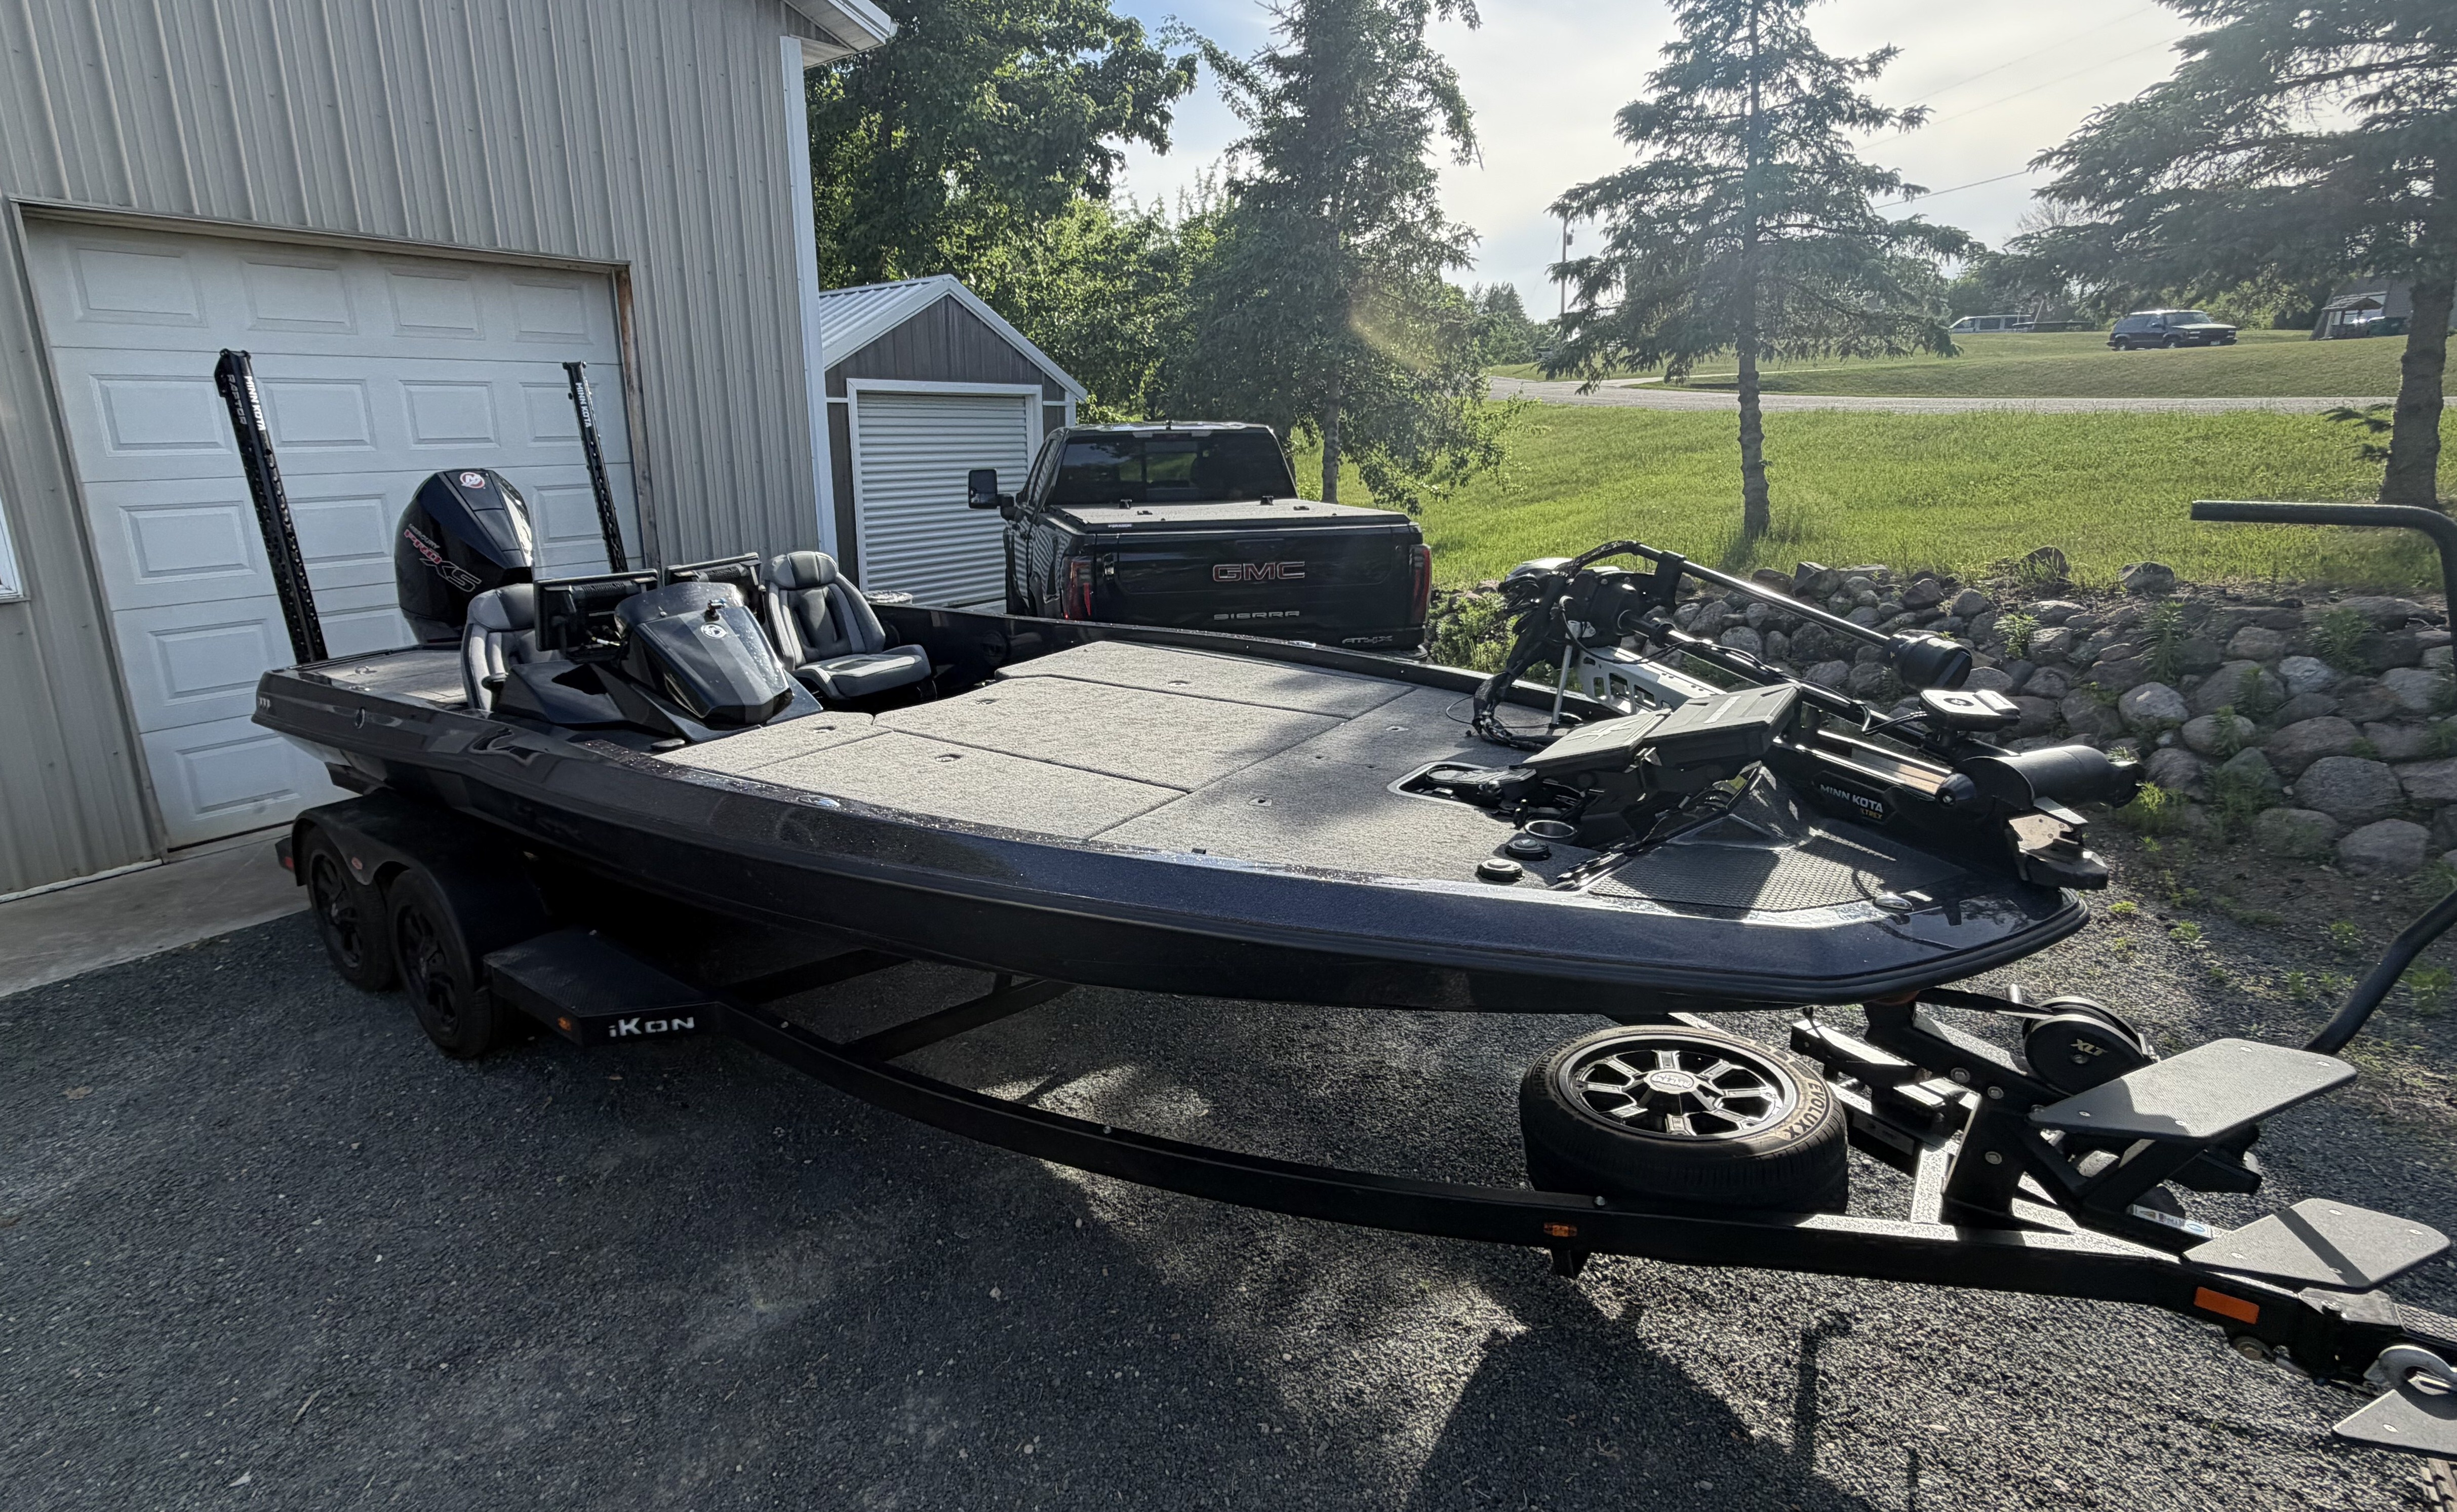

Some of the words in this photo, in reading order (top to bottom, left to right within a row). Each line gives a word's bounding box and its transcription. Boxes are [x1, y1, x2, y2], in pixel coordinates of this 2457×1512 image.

[227, 374, 247, 424] RAPTOR
[244, 376, 259, 404] MINN
[252, 405, 266, 430] KOTA
[575, 382, 587, 405] MINN
[581, 406, 591, 428] KOTA
[404, 529, 443, 564] PRO
[419, 558, 482, 592] XS
[1212, 561, 1305, 582] GMC
[1213, 611, 1300, 620] SIERRA
[1342, 635, 1393, 644] AT4X
[1820, 784, 1850, 801] MINN
[1852, 794, 1883, 813] KOTA
[2070, 1039, 2108, 1057] XLT
[1782, 1082, 1826, 1139] EVOLUXX
